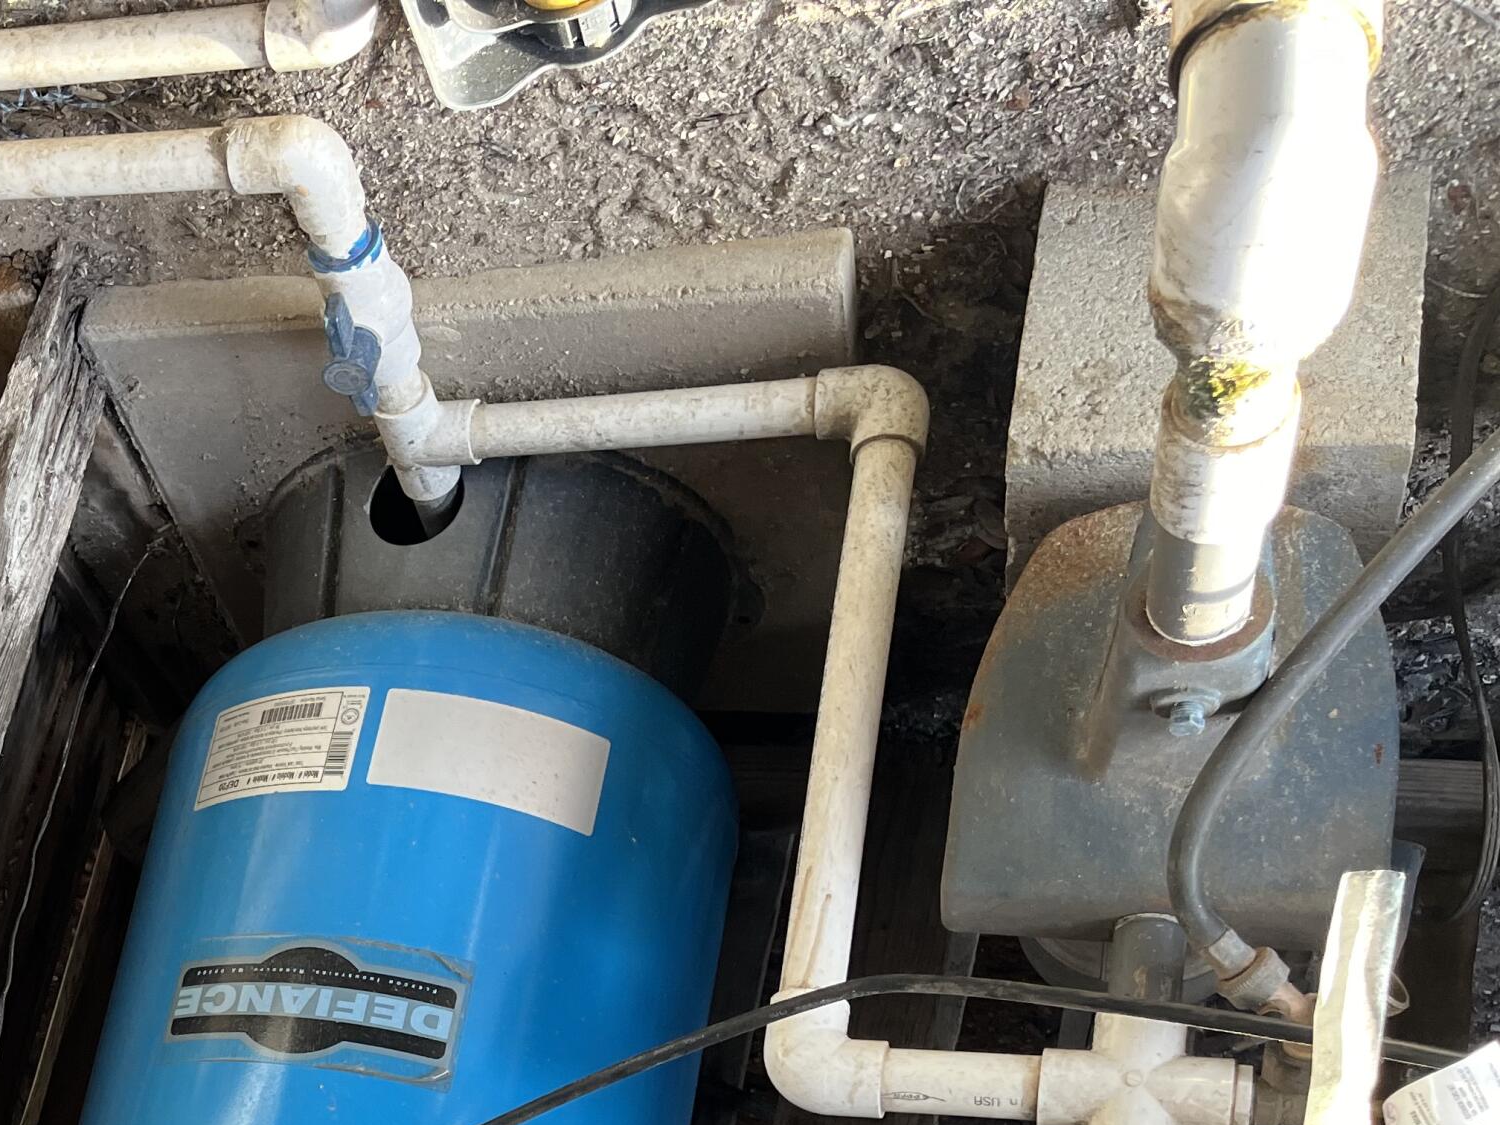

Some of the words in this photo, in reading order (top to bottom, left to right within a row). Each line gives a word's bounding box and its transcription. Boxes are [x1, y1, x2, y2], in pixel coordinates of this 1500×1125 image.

[303, 769, 319, 779] Model
[219, 779, 239, 791] DEF20
[174, 984, 453, 1040] DEFIANCE
[973, 1095, 1000, 1107] USA
